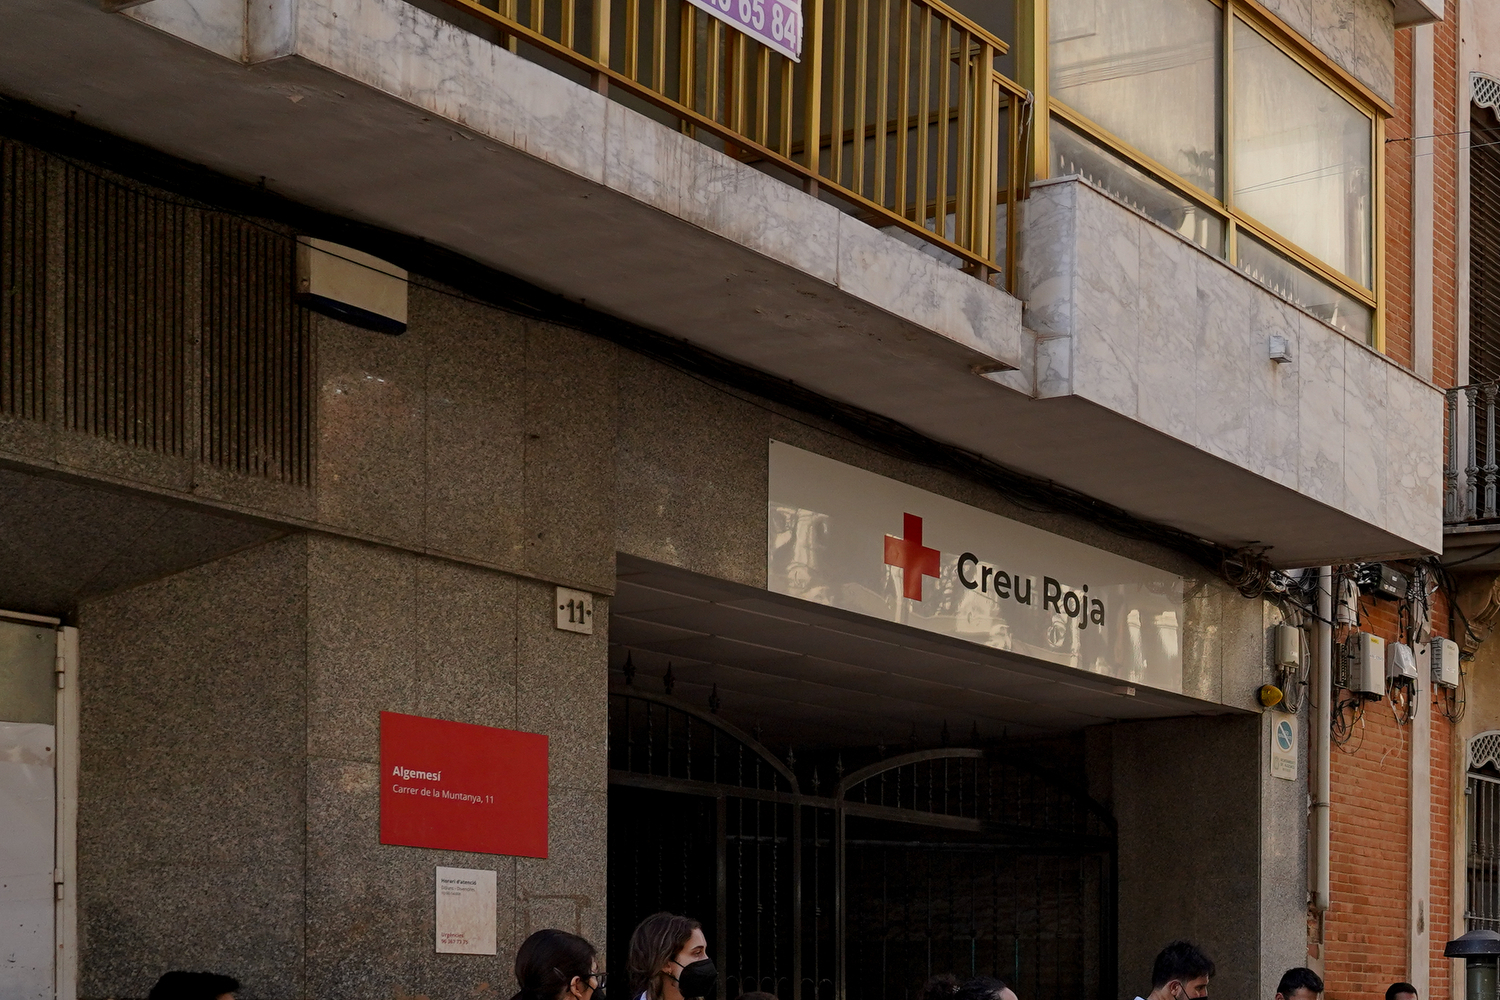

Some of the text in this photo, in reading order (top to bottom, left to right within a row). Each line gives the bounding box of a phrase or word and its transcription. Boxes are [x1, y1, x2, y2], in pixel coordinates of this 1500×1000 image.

[771, 3, 796, 49] 84
[957, 552, 1106, 630] Creu Roja
[567, 598, 585, 624] 11
[393, 766, 442, 781] Algemesí
[392, 784, 495, 804] Carrer de la Muntanya, 11
